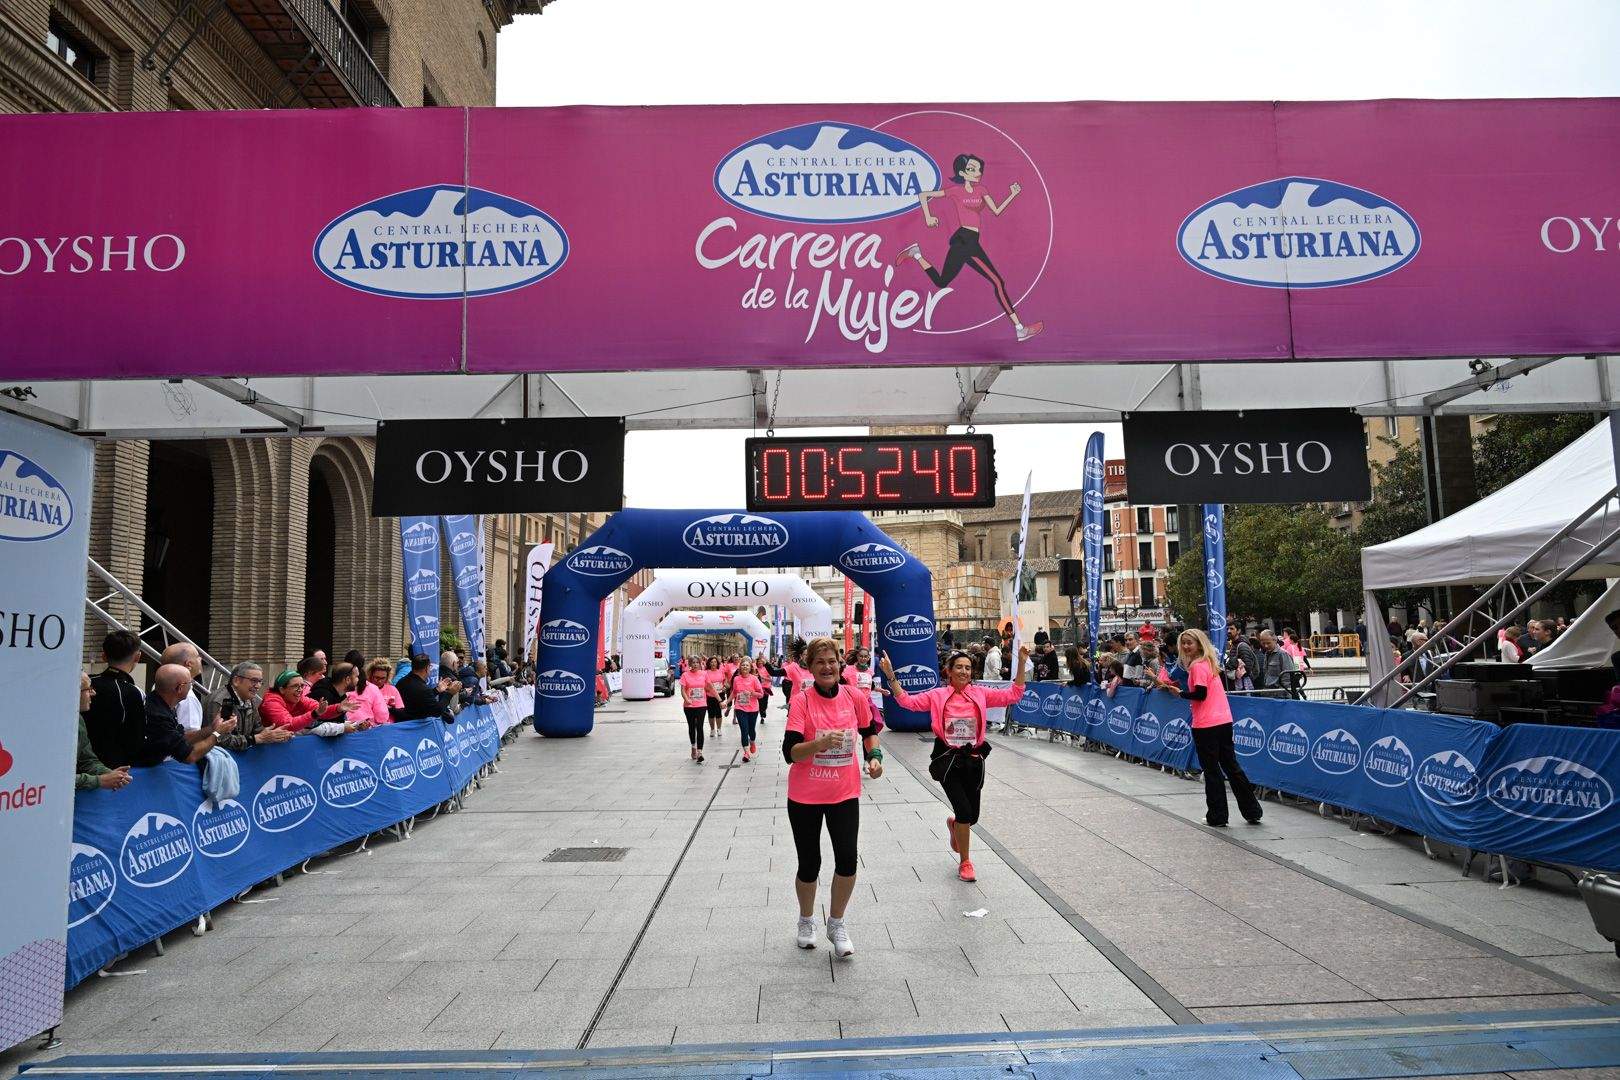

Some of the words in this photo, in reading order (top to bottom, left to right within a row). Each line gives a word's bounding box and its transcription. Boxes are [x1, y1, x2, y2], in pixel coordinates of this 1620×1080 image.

[767, 157, 838, 167] CENTRAL
[844, 156, 916, 167] LECHERA
[732, 158, 923, 197] ASTURIANA
[374, 224, 452, 237] CENTRAL
[460, 223, 541, 236] LECHERA
[1232, 215, 1309, 227] CENTRAL
[1314, 213, 1393, 226] LECHERA
[695, 217, 883, 270] Carrera
[1197, 219, 1404, 260] ASTURIANA
[1540, 216, 1620, 253] OY
[0, 233, 187, 275] OYSHO
[332, 228, 550, 270] ASTURIANA
[741, 273, 776, 310] de
[784, 271, 810, 310] la
[804, 264, 955, 353] Mujer
[415, 449, 590, 484] OYSHO
[1164, 440, 1333, 476] OYSHO
[690, 527, 782, 547] ASTURIANA
[569, 555, 628, 569] ASTURIANA
[845, 554, 902, 567] ASTURIANA
[687, 580, 769, 599] OYSHO
[542, 629, 586, 641] ASTURIANA
[888, 625, 932, 637] ASTURIANA
[537, 679, 582, 692] ASTURIANA
[898, 675, 936, 687] STURIANA
[1269, 735, 1305, 757] ASTURIANA
[1313, 742, 1357, 766] ASTURIANA
[809, 768, 840, 779] SUMA
[326, 775, 376, 801] ASTURIANA
[1494, 775, 1602, 809] ASTURIANA
[258, 793, 314, 825] ASTURIANA
[197, 817, 248, 848] ASTURIANA
[128, 837, 192, 878] ASTURIANA
